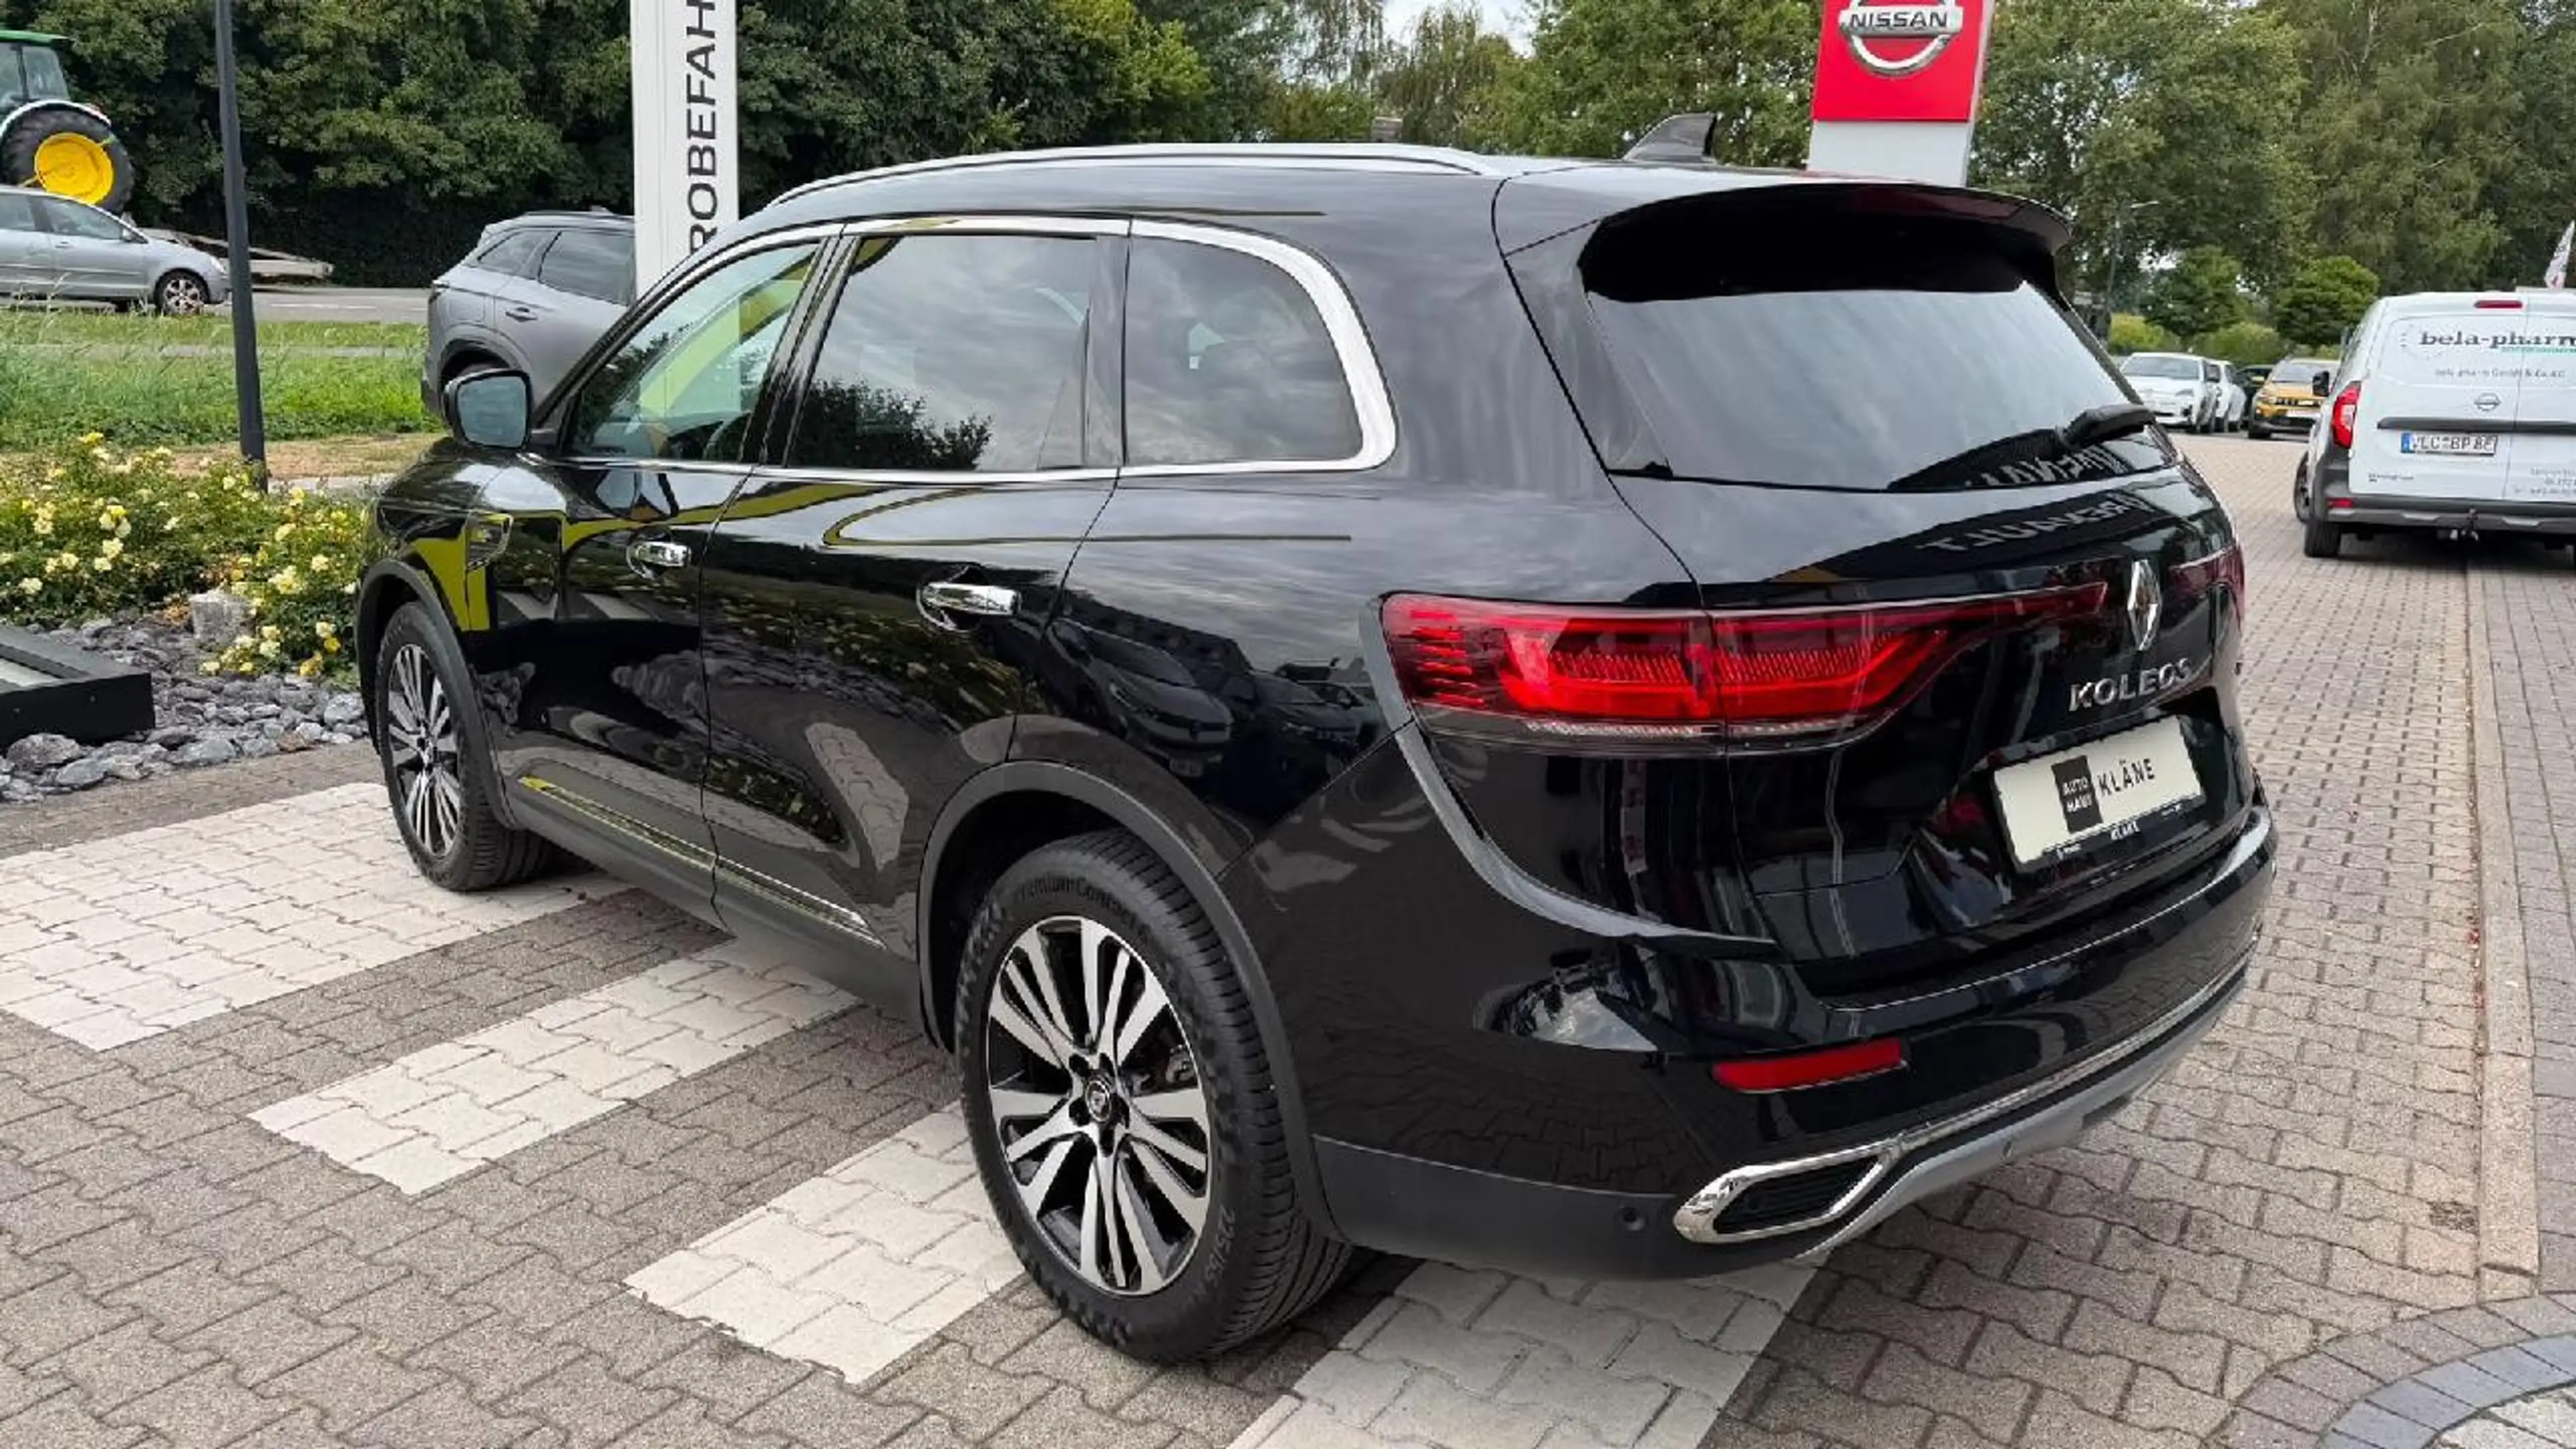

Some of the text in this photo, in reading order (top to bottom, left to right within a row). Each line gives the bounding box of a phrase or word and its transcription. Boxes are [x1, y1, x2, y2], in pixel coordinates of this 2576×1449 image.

[1849, 10, 1948, 28] NISSAN
[2069, 657, 2192, 711] KOLEOS
[2097, 758, 2155, 797] KLÄNE
